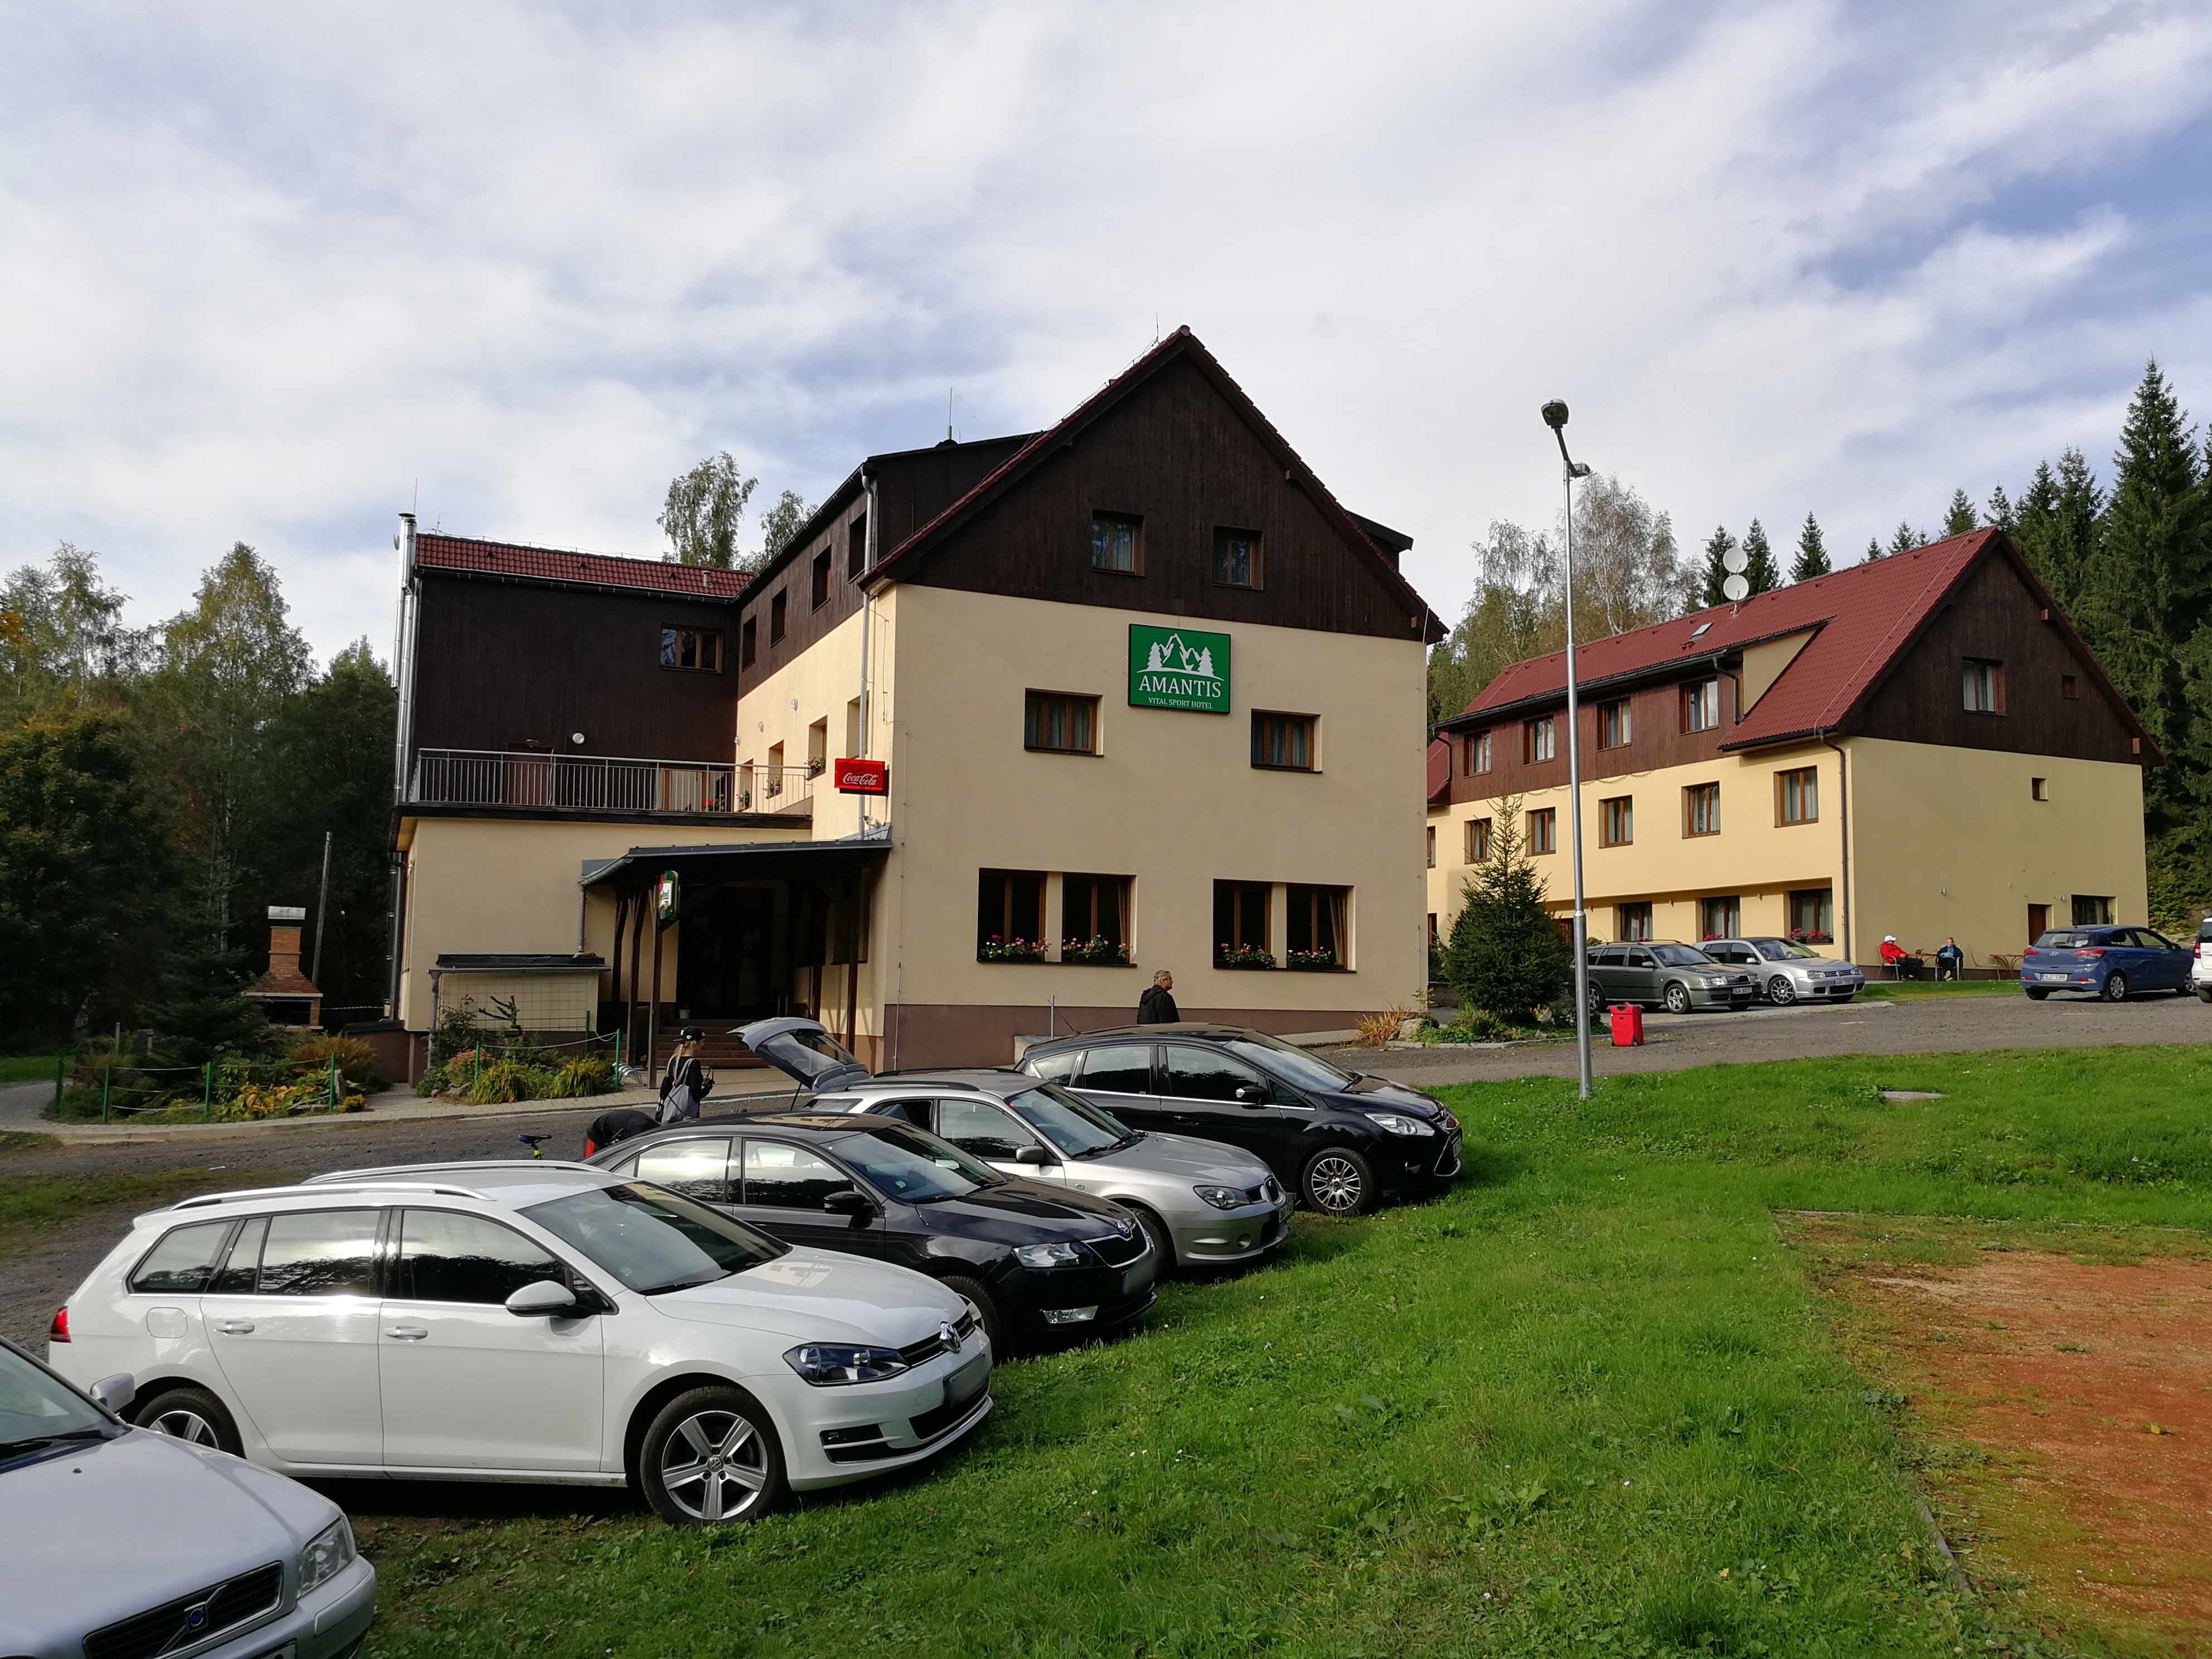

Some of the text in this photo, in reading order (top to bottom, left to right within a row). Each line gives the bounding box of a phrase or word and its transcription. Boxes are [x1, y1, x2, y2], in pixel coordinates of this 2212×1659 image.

[1138, 675, 1221, 698] AMANTIS
[1148, 697, 1167, 705] VITAL
[1191, 701, 1214, 709] HOTEL
[843, 772, 879, 785] Coca-Cola
